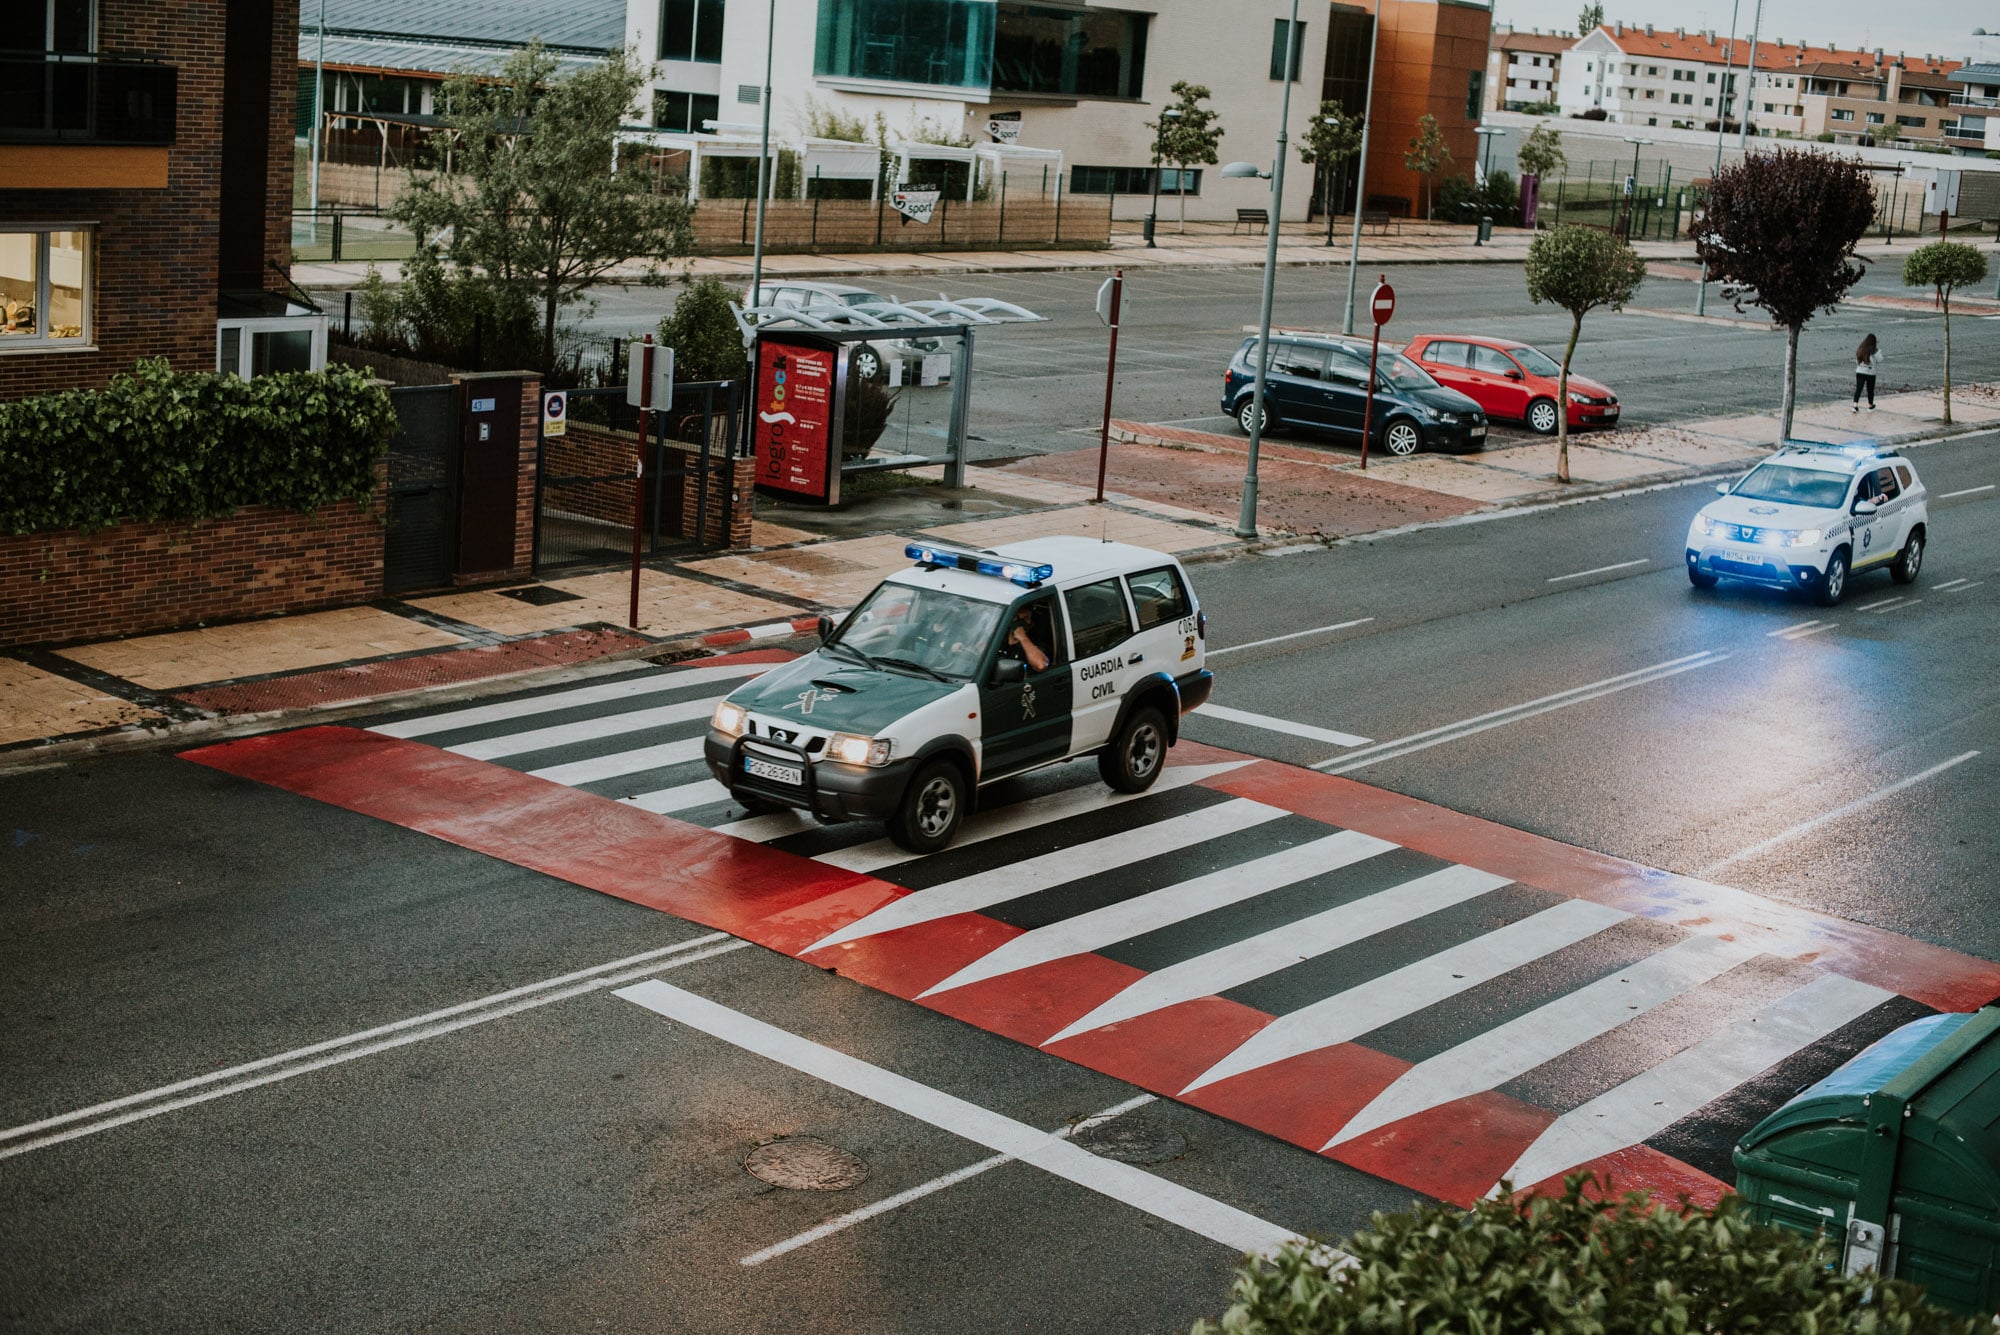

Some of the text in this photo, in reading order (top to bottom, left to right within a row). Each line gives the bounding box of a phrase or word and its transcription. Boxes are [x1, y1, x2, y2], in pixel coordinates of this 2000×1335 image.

[1000, 131, 1018, 140] sport
[908, 201, 932, 216] sport
[473, 400, 482, 410] 43
[1183, 616, 1198, 634] 062
[1080, 656, 1124, 681] GUARDIA
[1092, 681, 1115, 699] CIVIL
[750, 760, 799, 783] PGC 2639 N
